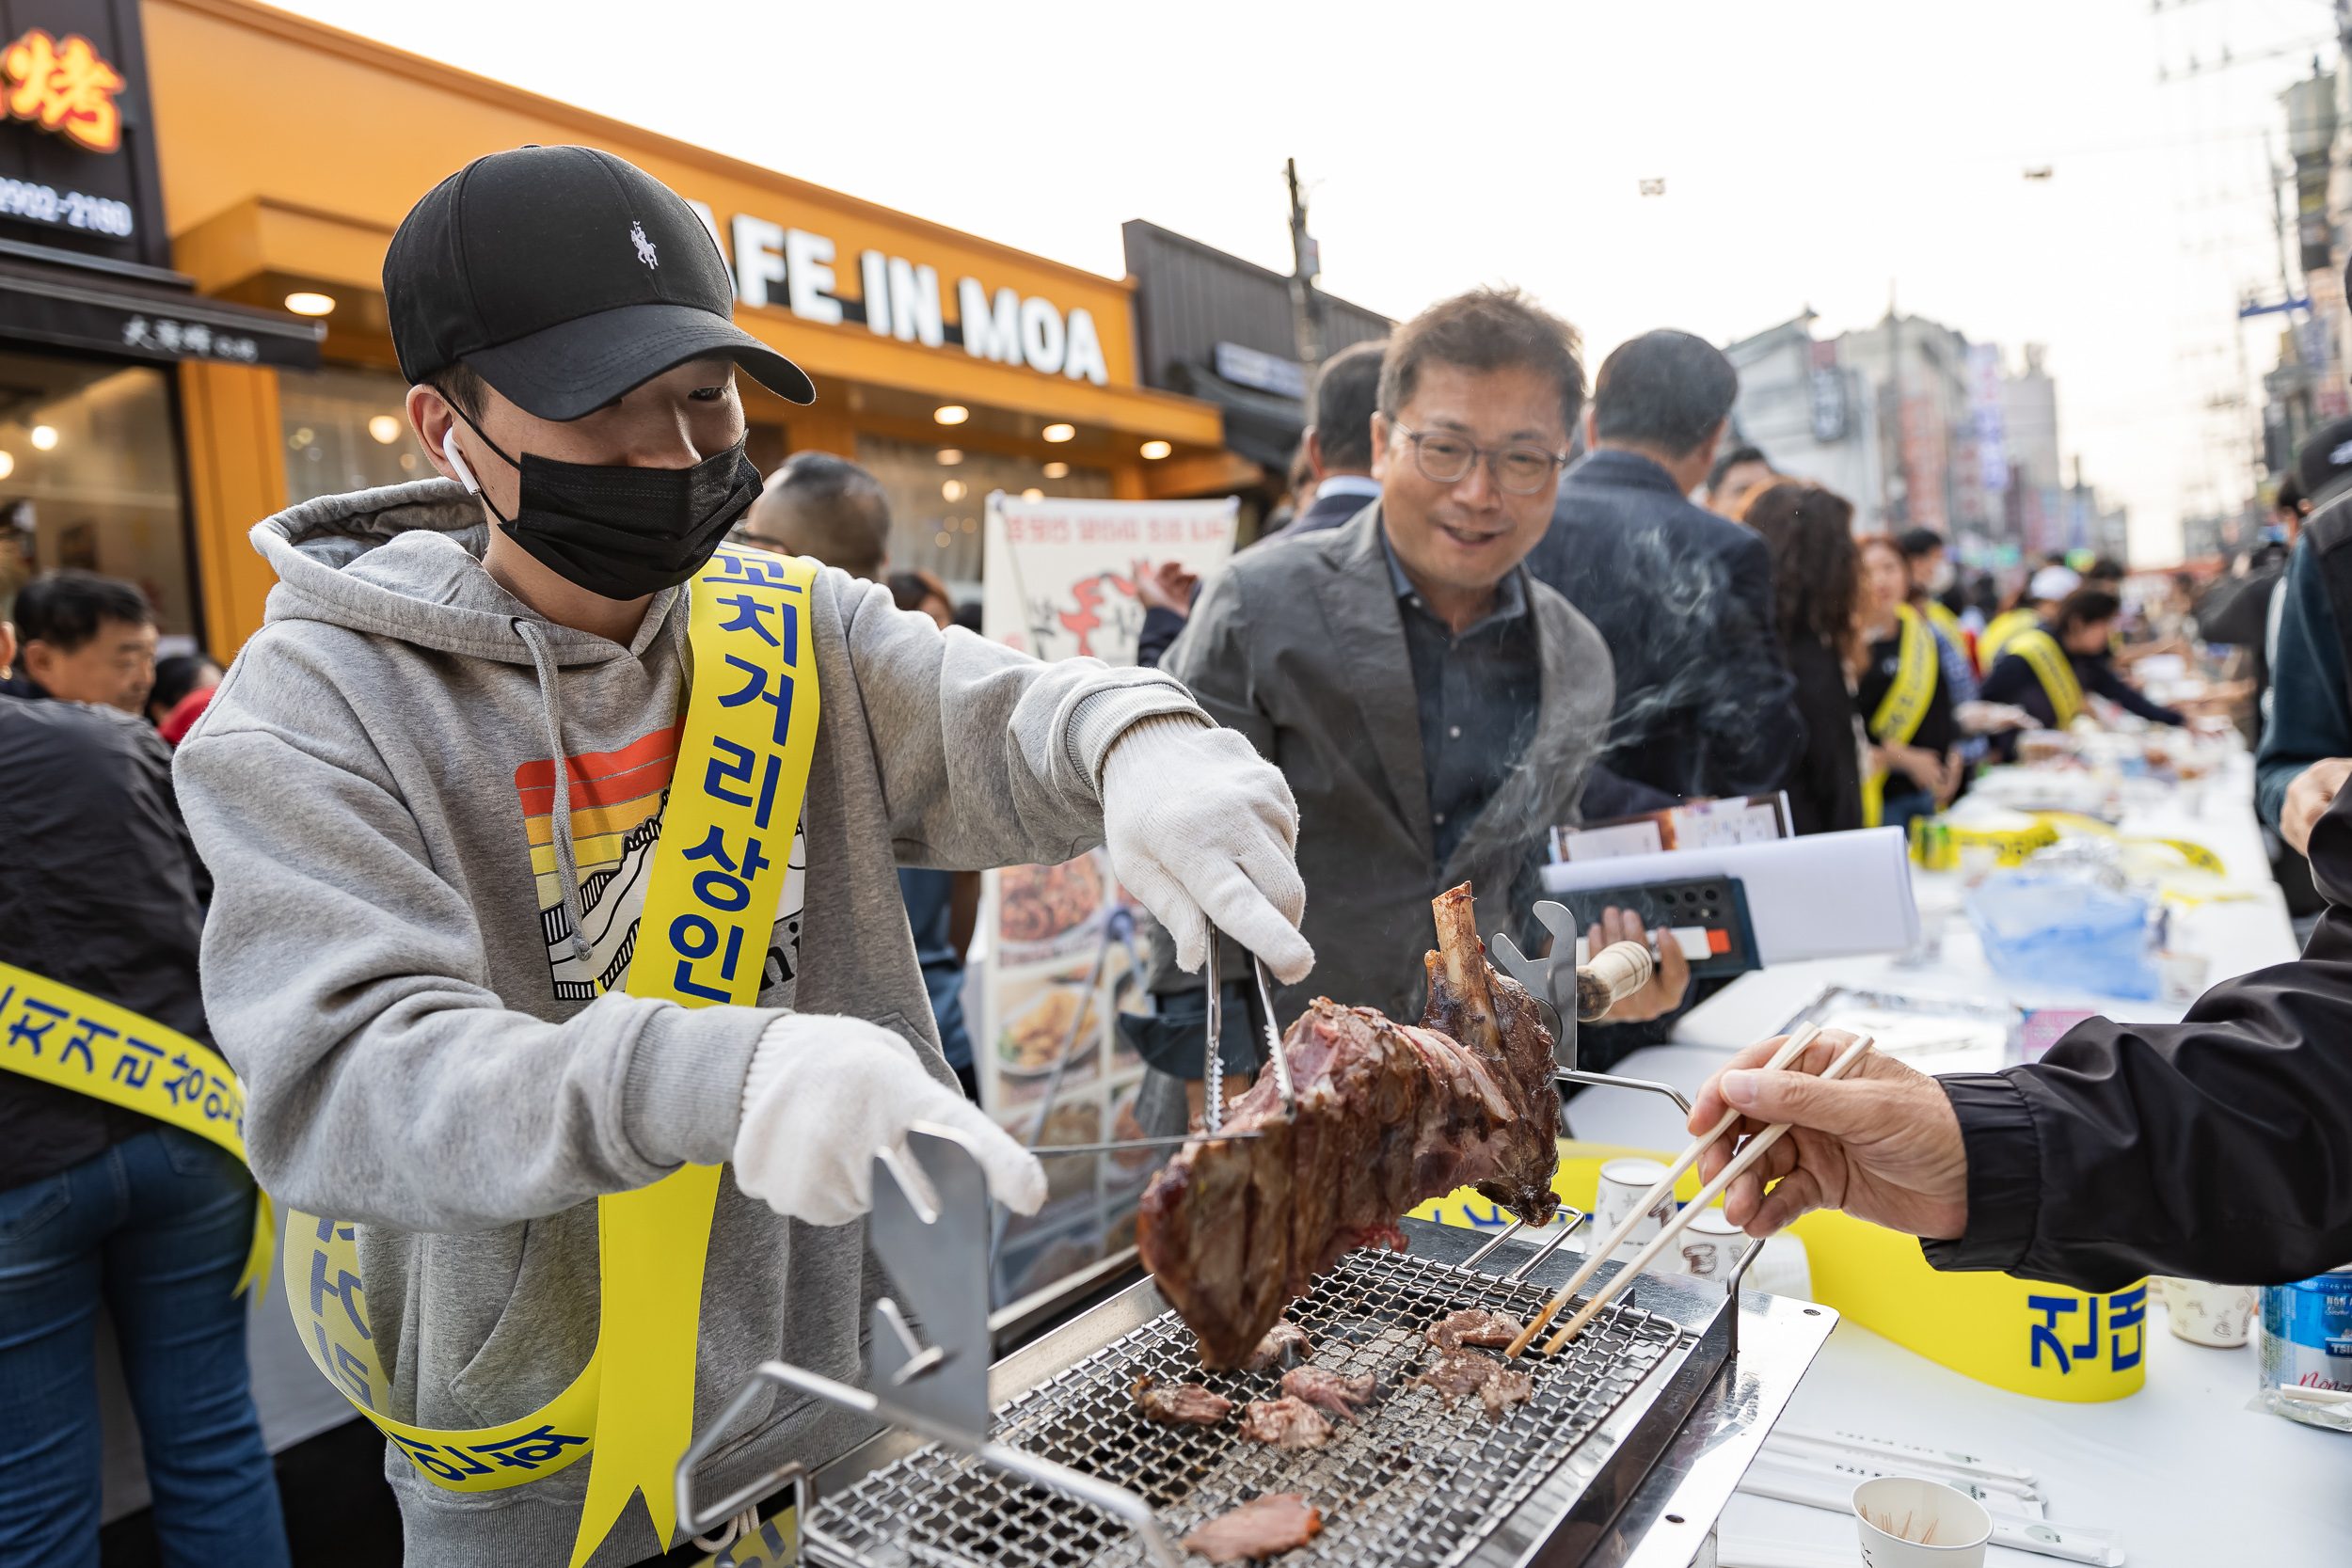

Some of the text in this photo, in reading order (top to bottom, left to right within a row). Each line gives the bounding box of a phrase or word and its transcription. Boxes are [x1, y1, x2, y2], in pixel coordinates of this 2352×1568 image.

[861, 249, 945, 348] IN
[958, 276, 1108, 386] MOA
[669, 543, 803, 1004] 꼬치거리상인
[0, 986, 243, 1138] 치거리상인
